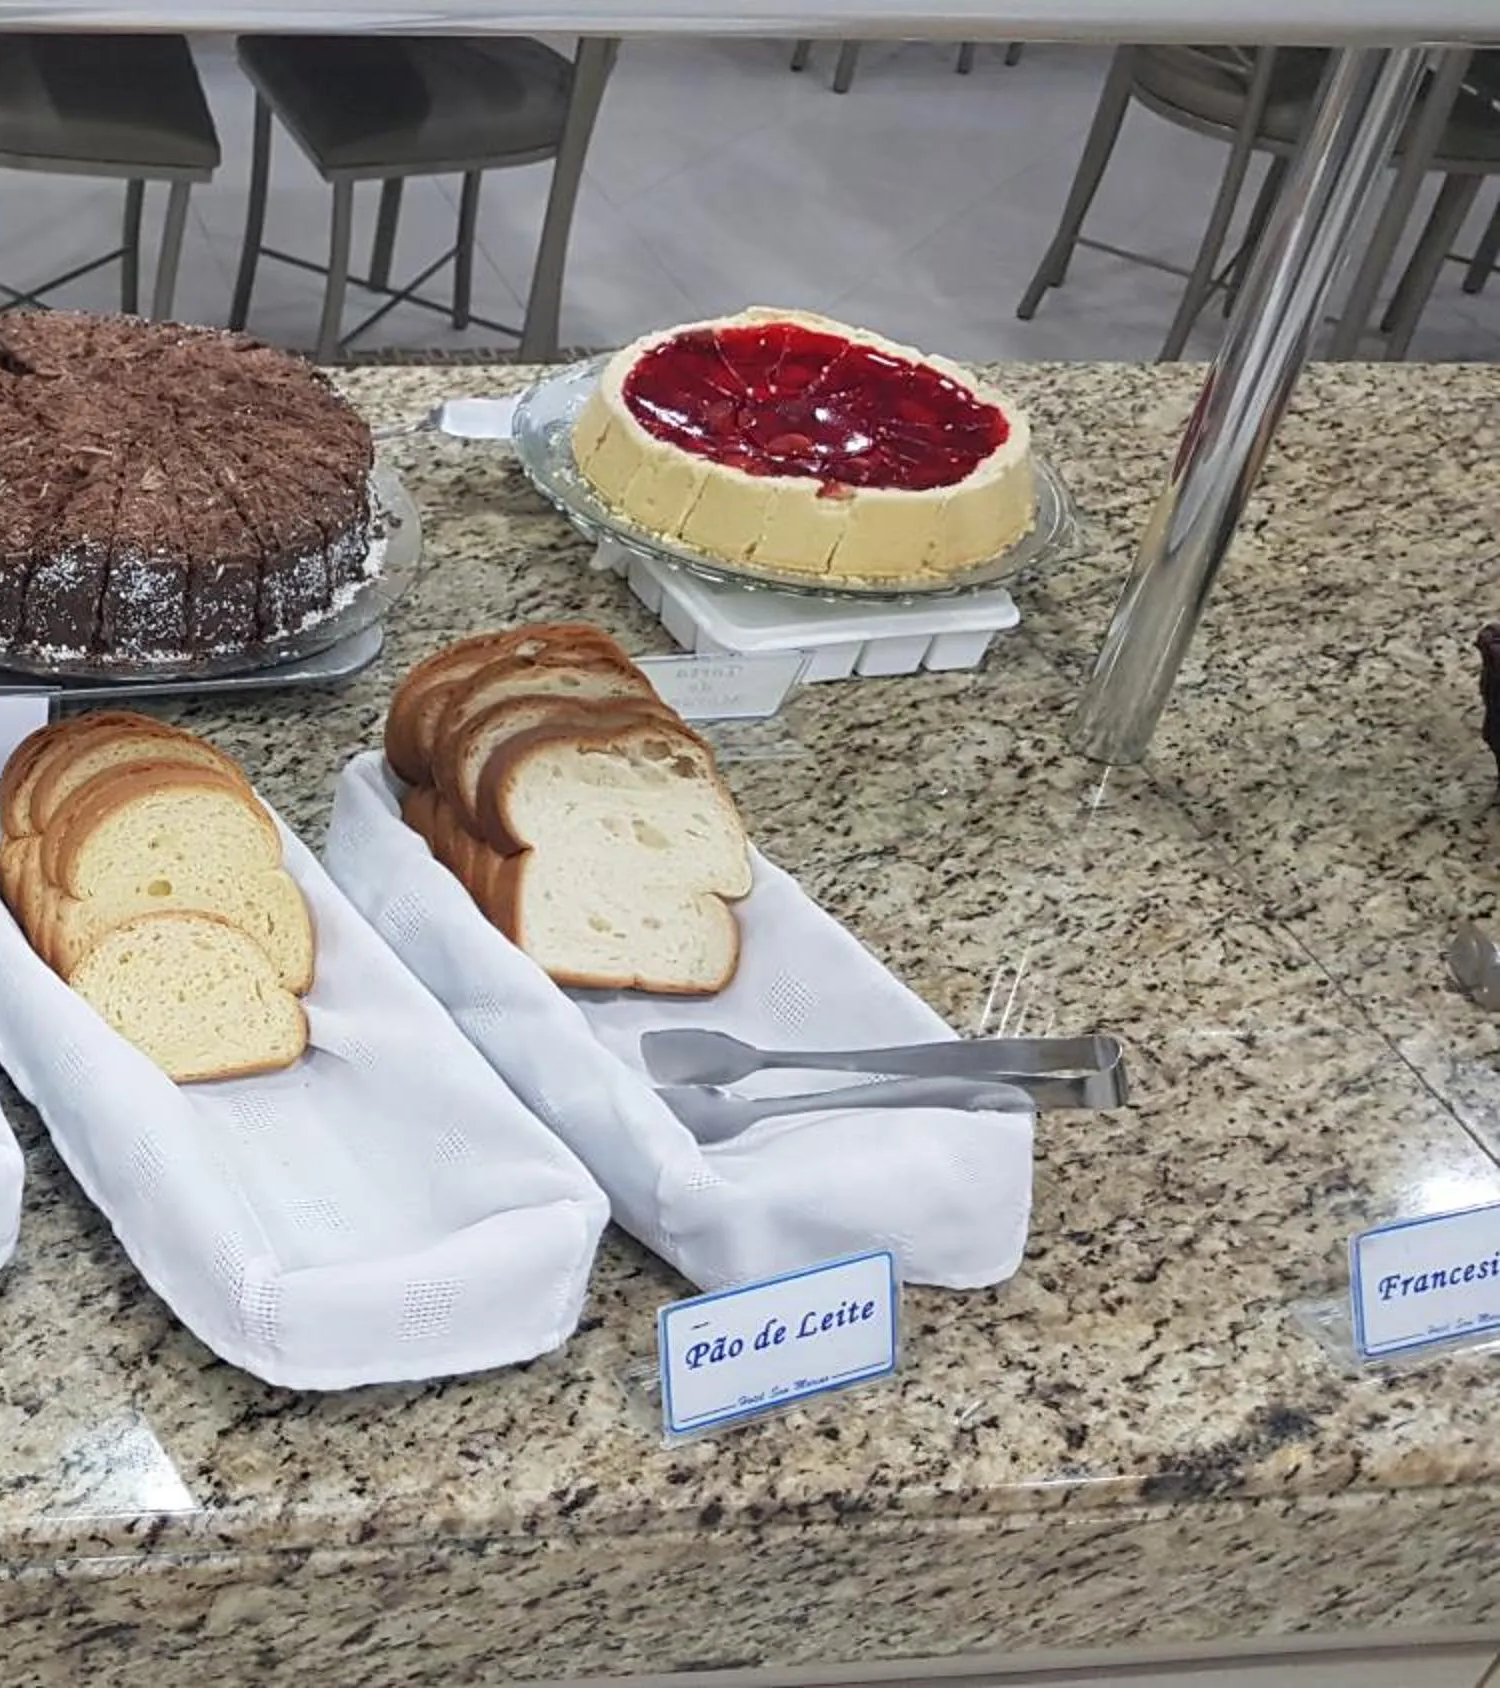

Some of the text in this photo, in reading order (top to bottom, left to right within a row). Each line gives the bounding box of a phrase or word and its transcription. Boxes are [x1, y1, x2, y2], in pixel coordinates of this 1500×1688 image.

[1378, 1251, 1500, 1300] Francesi
[685, 1300, 875, 1370] Pão de Leite
